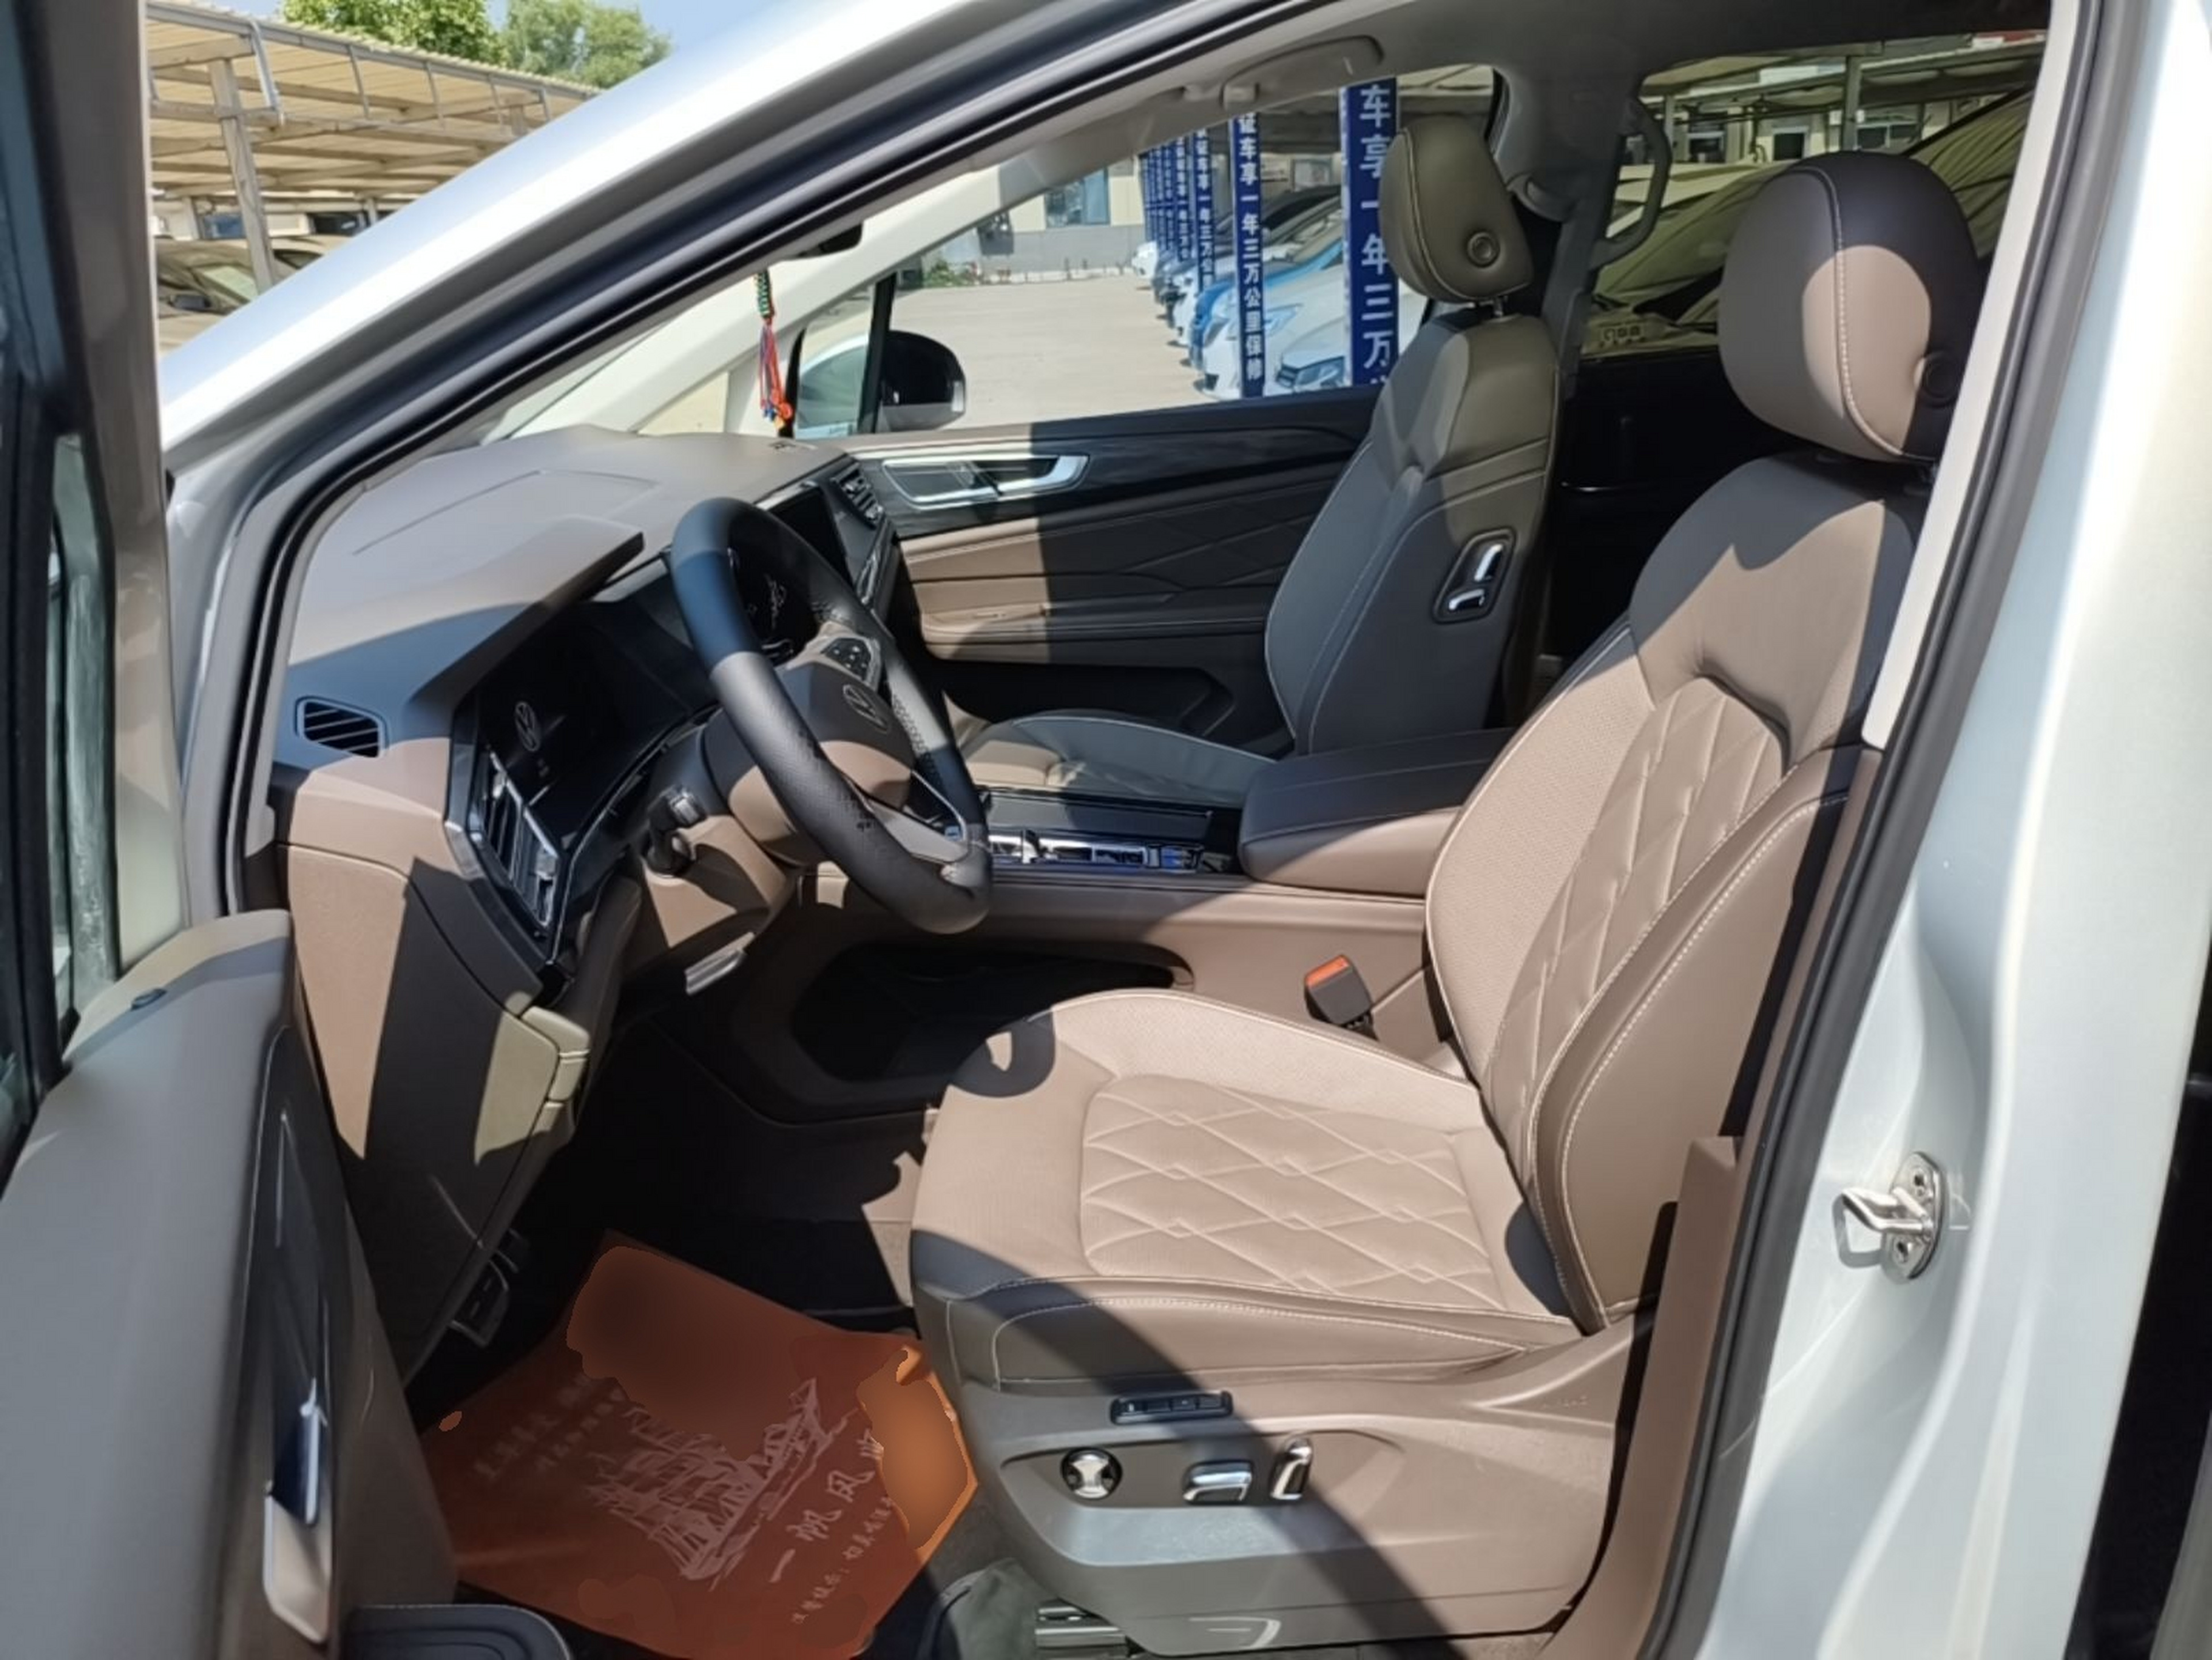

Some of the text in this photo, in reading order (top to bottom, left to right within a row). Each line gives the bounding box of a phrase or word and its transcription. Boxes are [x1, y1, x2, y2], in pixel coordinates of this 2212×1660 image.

[1359, 85, 1393, 385] 车享一年三万
